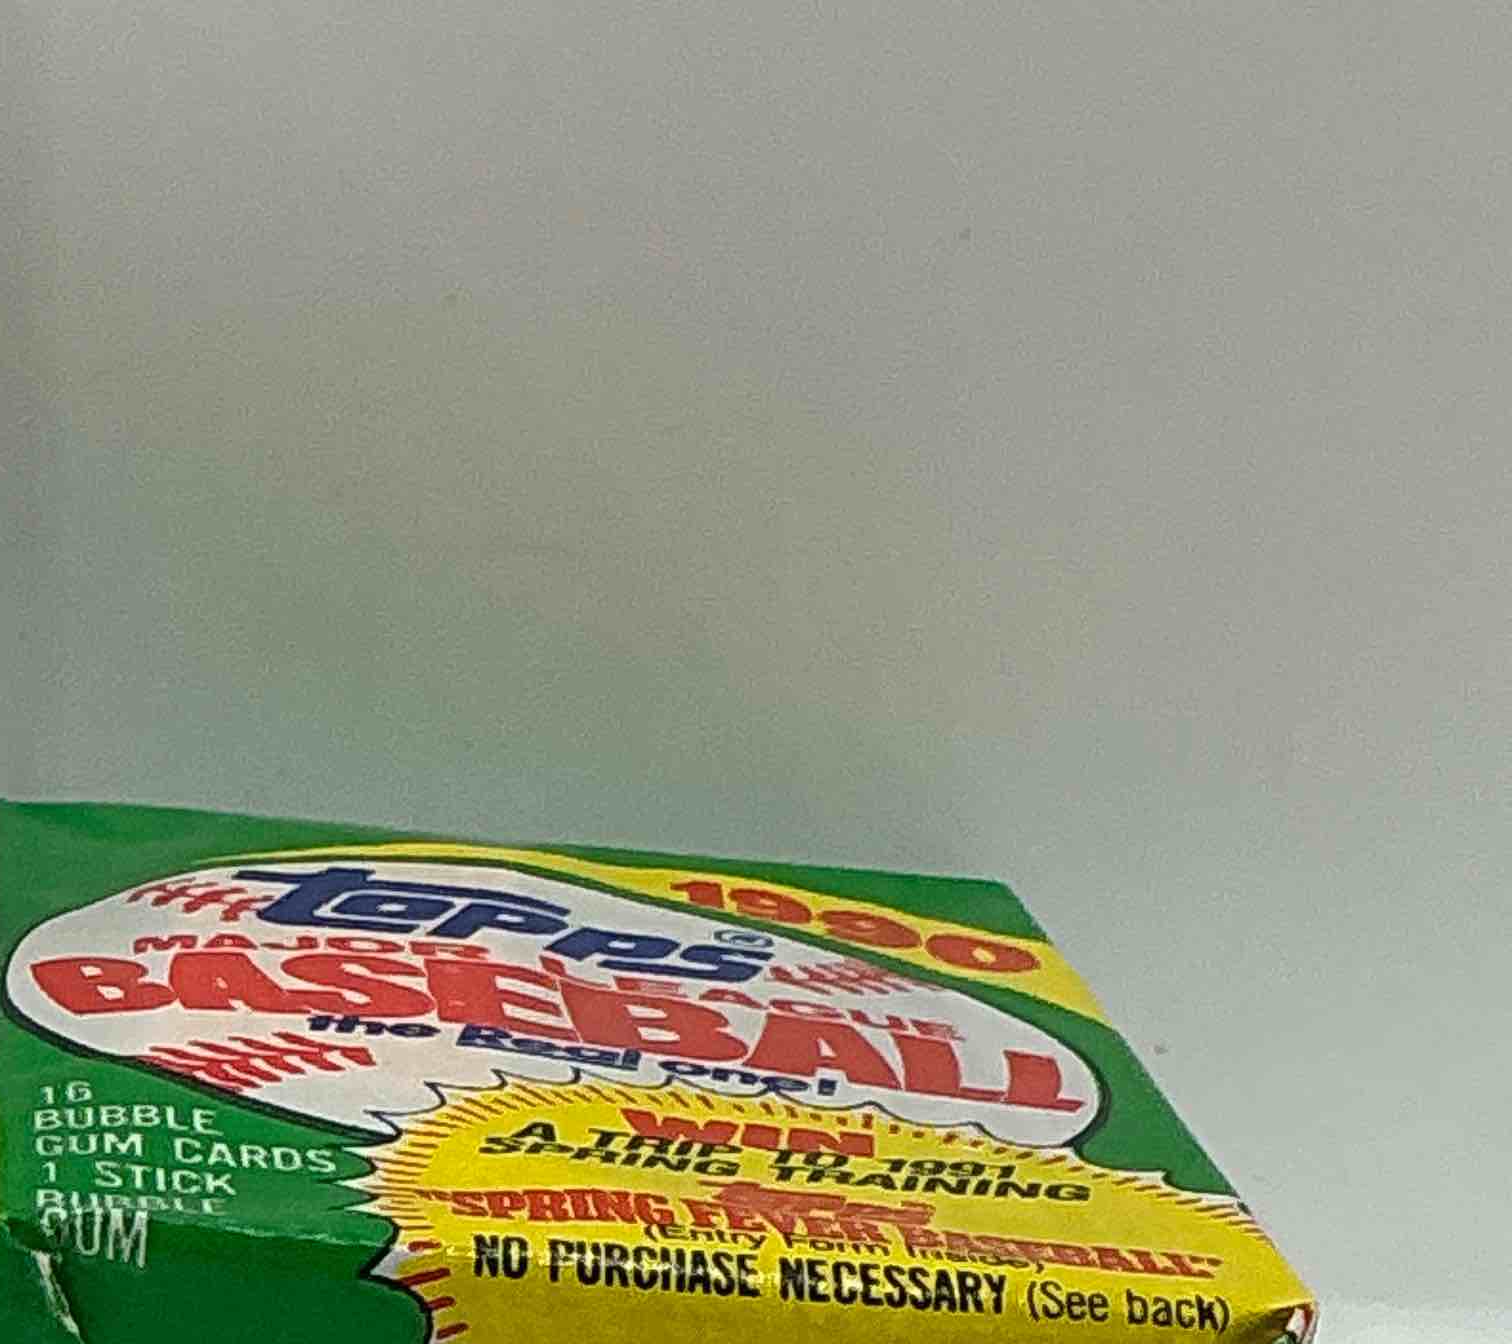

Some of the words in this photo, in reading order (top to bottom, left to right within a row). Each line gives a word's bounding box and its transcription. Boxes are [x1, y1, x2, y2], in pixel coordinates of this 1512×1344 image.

[133, 934, 490, 957] MAJOR
[671, 880, 1041, 973] 1990
[30, 952, 1092, 1113] BASEBALL
[307, 1014, 439, 1037] the
[456, 1024, 641, 1070] Real
[659, 1060, 837, 1096] one!
[42, 1081, 92, 1104] 16
[34, 1105, 224, 1136] BUBBLE
[619, 1108, 874, 1156] WIN
[35, 1133, 144, 1157] GUM
[172, 1137, 336, 1173] CARDS
[508, 1121, 556, 1142] A
[588, 1128, 742, 1155] TRIP
[884, 1158, 1017, 1179] 1991
[42, 1161, 56, 1183] 1
[95, 1161, 236, 1195] STICK
[769, 1165, 1091, 1201] TRAINING
[473, 1234, 528, 1278] NO
[549, 1238, 761, 1297] PURCHASE
[779, 1258, 1007, 1314] NECESSARY
[1028, 1280, 1110, 1323] (See
[1126, 1289, 1230, 1333] back)
